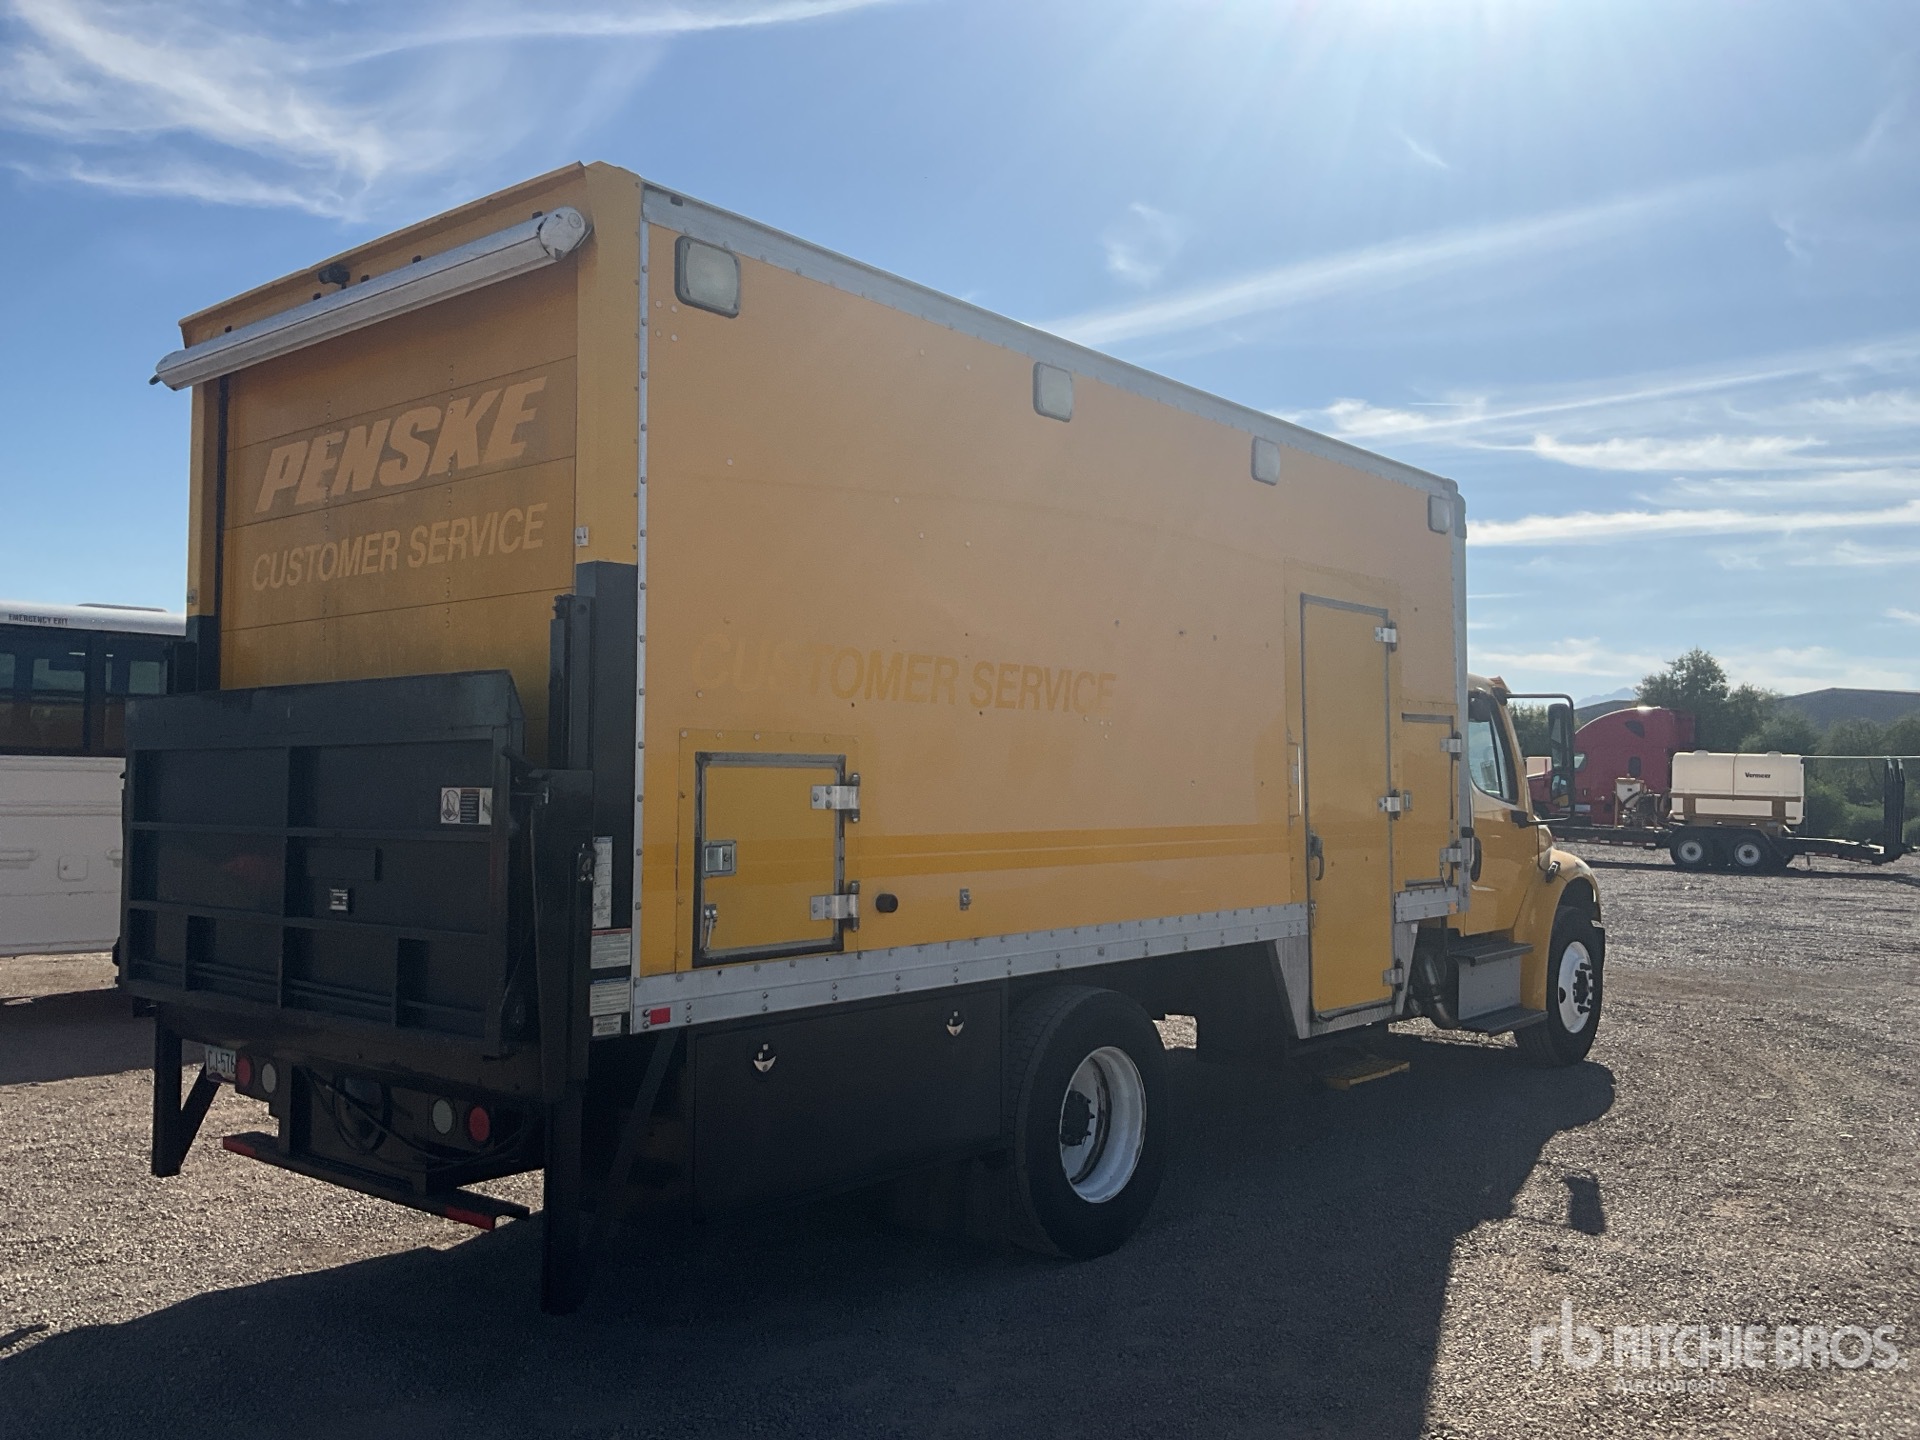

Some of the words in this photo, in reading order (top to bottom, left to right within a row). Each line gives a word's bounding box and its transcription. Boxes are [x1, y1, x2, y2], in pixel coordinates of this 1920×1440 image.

[254, 376, 548, 515] PENSKE
[251, 529, 401, 592] CUSTOMER
[407, 502, 548, 569] SERVICE
[8, 613, 51, 624] EMERGENCY
[53, 617, 69, 625] EXIT
[690, 630, 960, 706] CUSTOMER
[967, 659, 1119, 716] SERVICE
[1744, 771, 1771, 779] Vermeer
